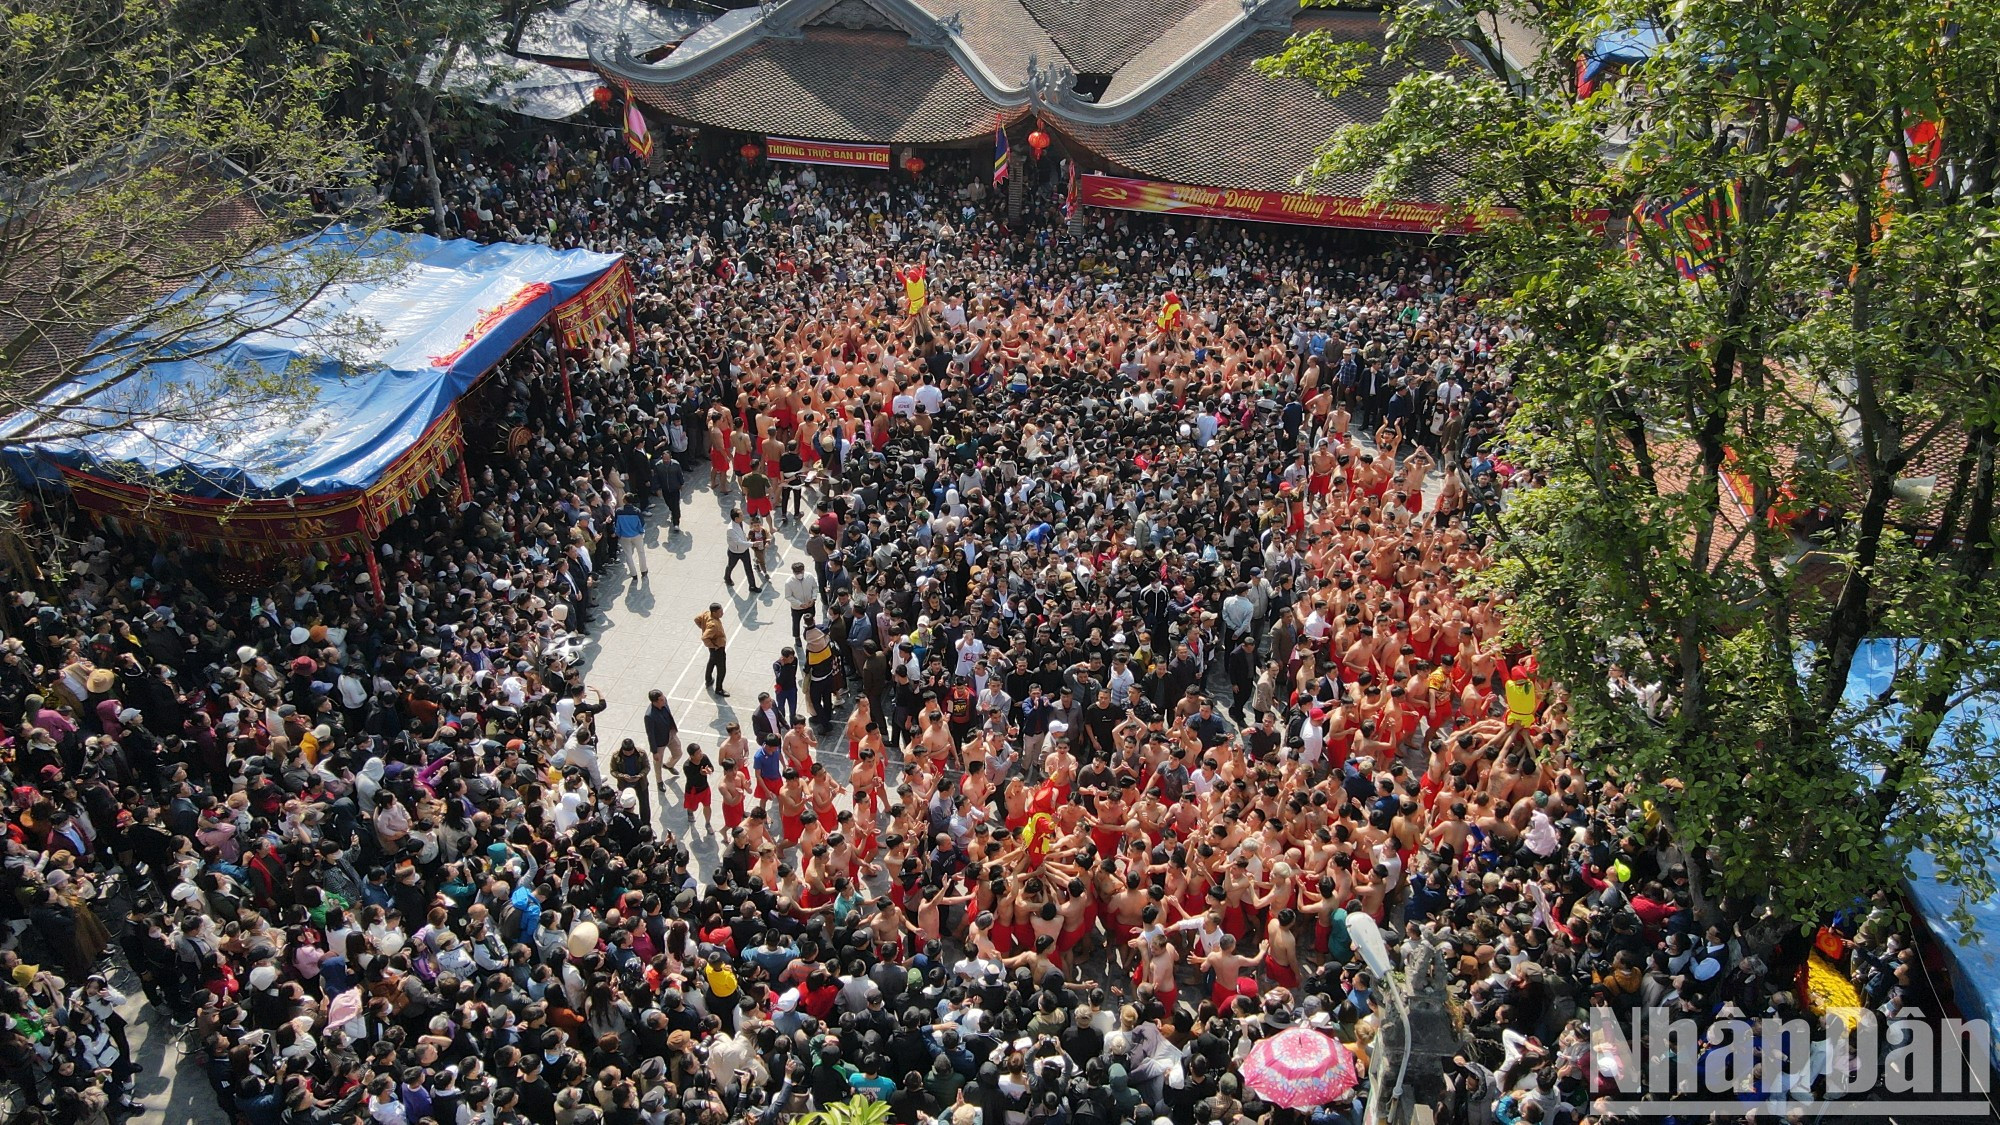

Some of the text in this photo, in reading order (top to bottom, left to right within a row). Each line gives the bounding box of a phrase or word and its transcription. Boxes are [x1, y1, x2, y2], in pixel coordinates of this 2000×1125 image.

[768, 144, 889, 163] THƯỜNG TRỰC BAN DI TÍCH
[1224, 190, 1265, 213] Đảng
